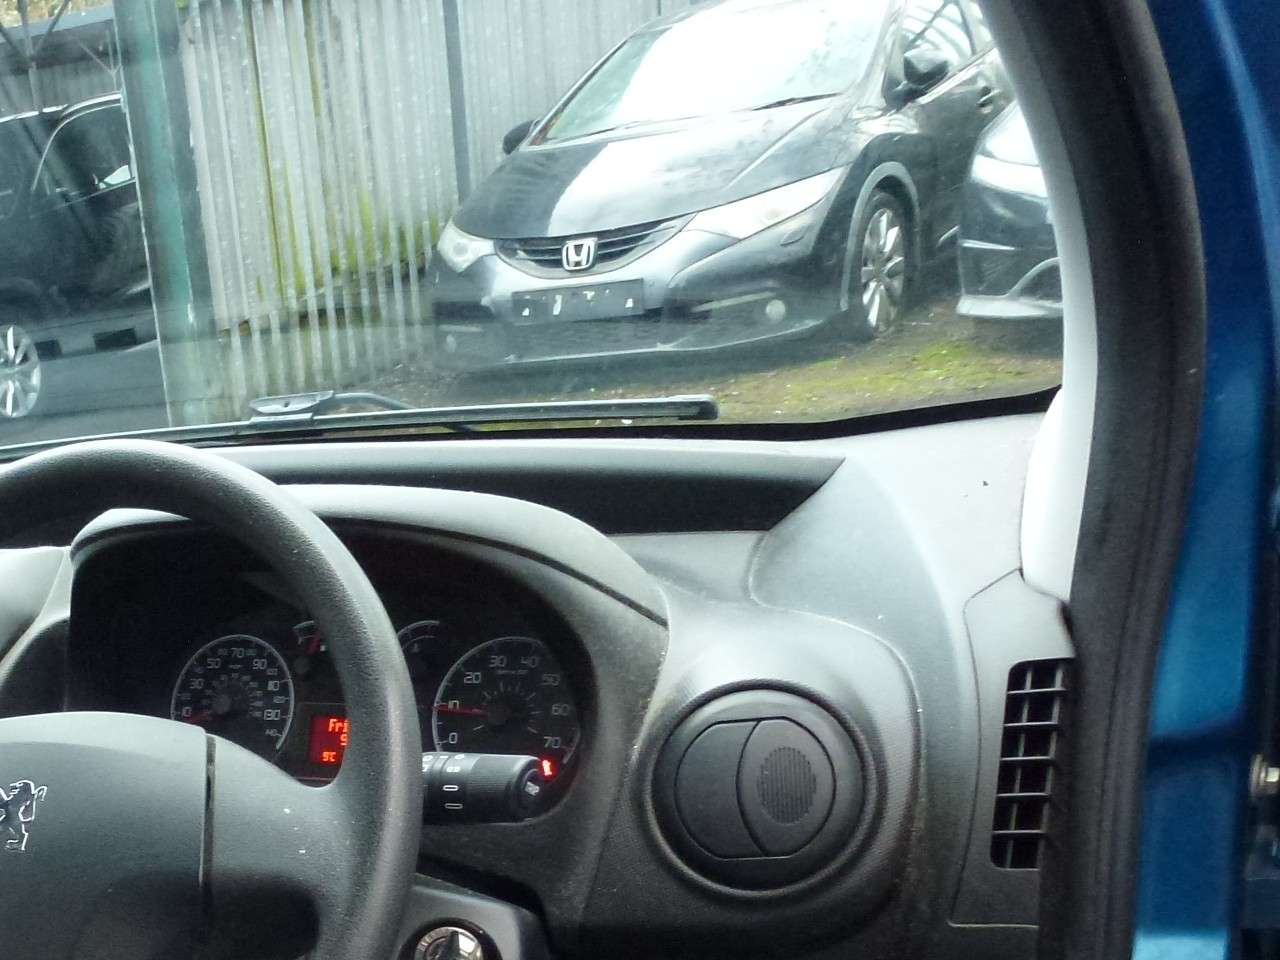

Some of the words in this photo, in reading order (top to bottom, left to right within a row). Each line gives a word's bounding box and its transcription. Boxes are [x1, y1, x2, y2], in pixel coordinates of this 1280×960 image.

[252, 658, 268, 670] 90
[489, 655, 507, 667] 30
[520, 656, 539, 668] 40
[463, 672, 482, 684] 20
[551, 703, 569, 716] 60
[543, 736, 561, 749] 70
